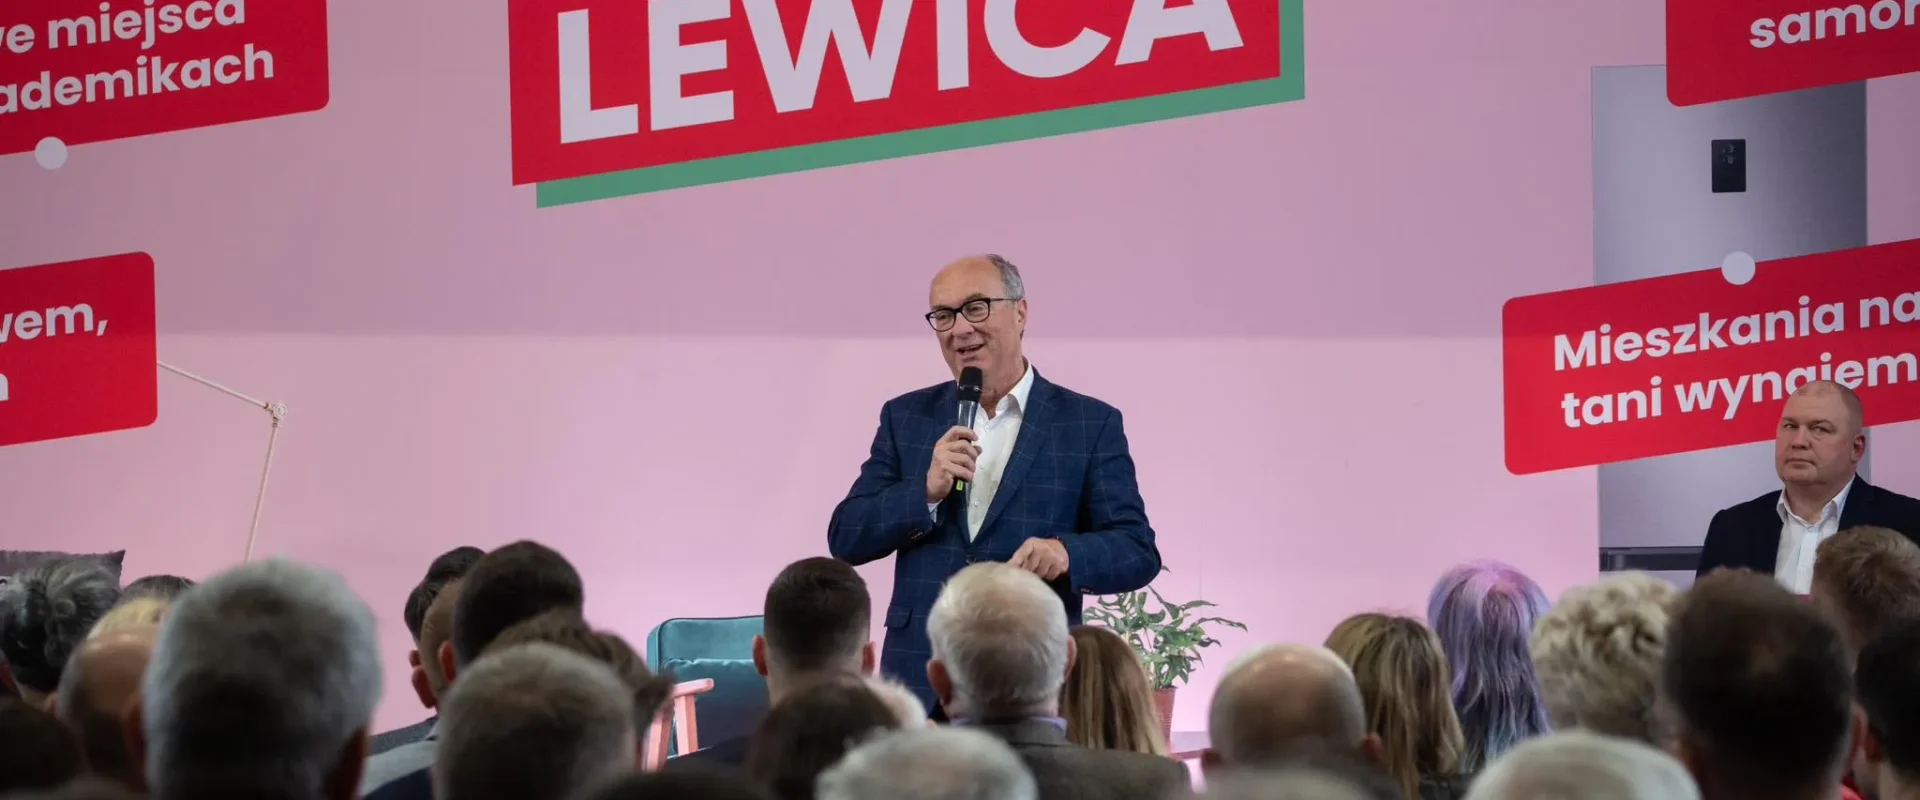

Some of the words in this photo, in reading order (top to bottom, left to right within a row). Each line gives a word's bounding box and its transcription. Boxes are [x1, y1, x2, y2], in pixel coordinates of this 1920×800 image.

[0, 23, 35, 53] e
[48, 0, 245, 50] miejsca
[557, 0, 1245, 145] LEWICA
[0, 303, 108, 343] em,
[1554, 295, 1845, 371] Mieszkania
[1859, 290, 1920, 328] na
[1560, 376, 1662, 428] tani
